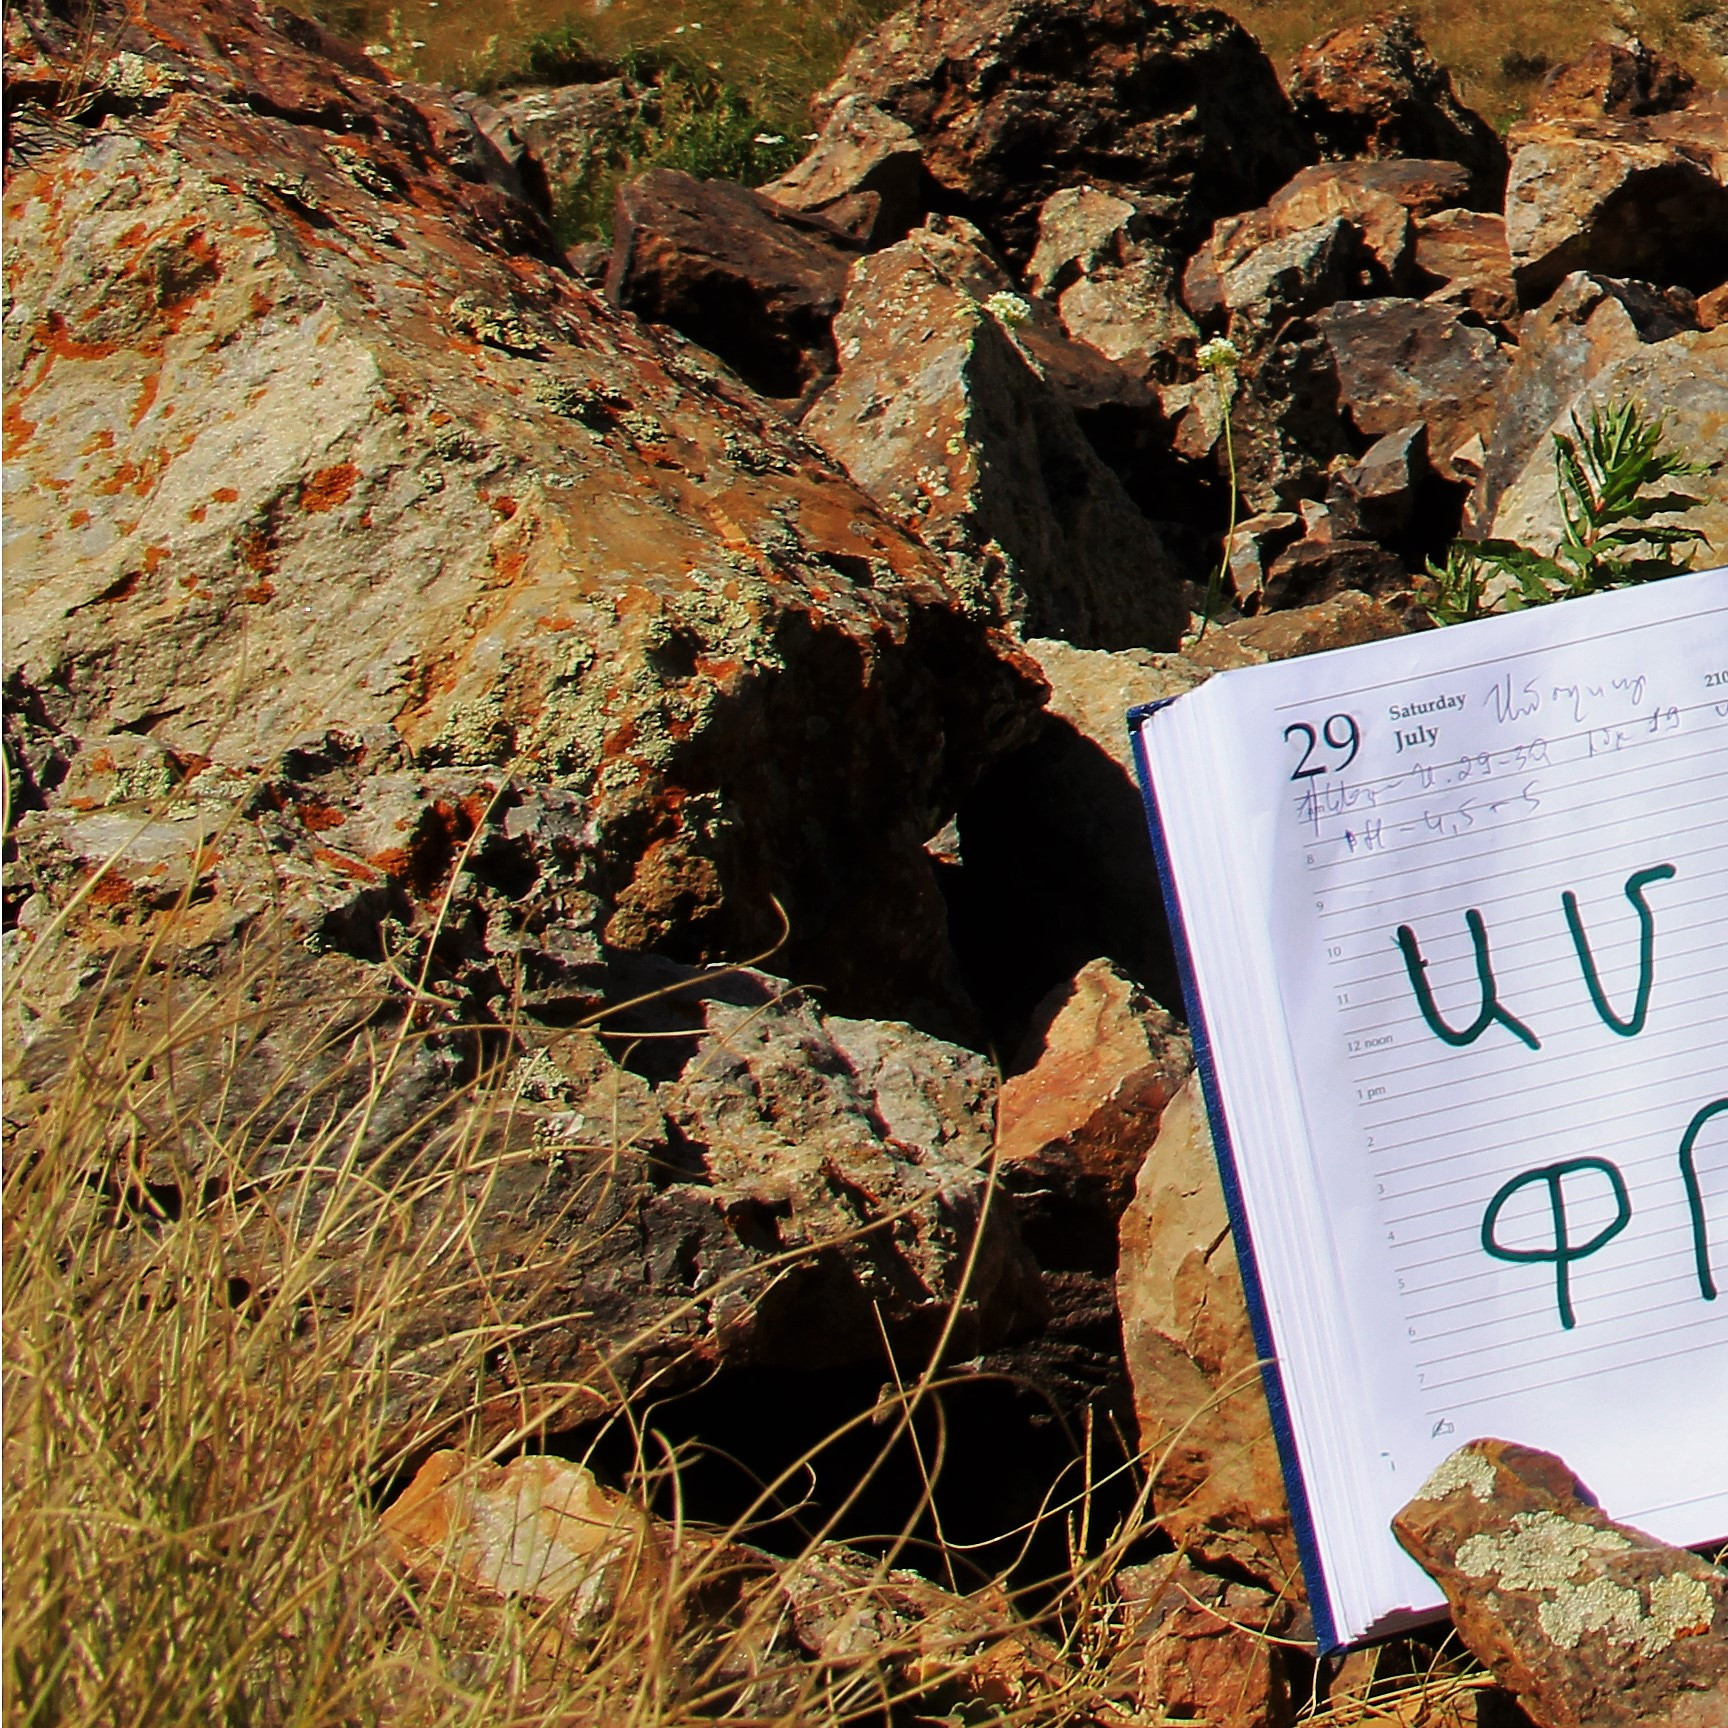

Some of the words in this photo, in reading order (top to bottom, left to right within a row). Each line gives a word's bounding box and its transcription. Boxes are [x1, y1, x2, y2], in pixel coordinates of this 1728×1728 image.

[1388, 693, 1467, 721] Saturday
[1283, 712, 1362, 782] 29
[1393, 724, 1440, 754] July
[1347, 1040, 1361, 1052] 12
[1364, 1034, 1394, 1048] noon
[1357, 1088, 1364, 1100] 1
[1367, 1084, 1387, 1101] pm
